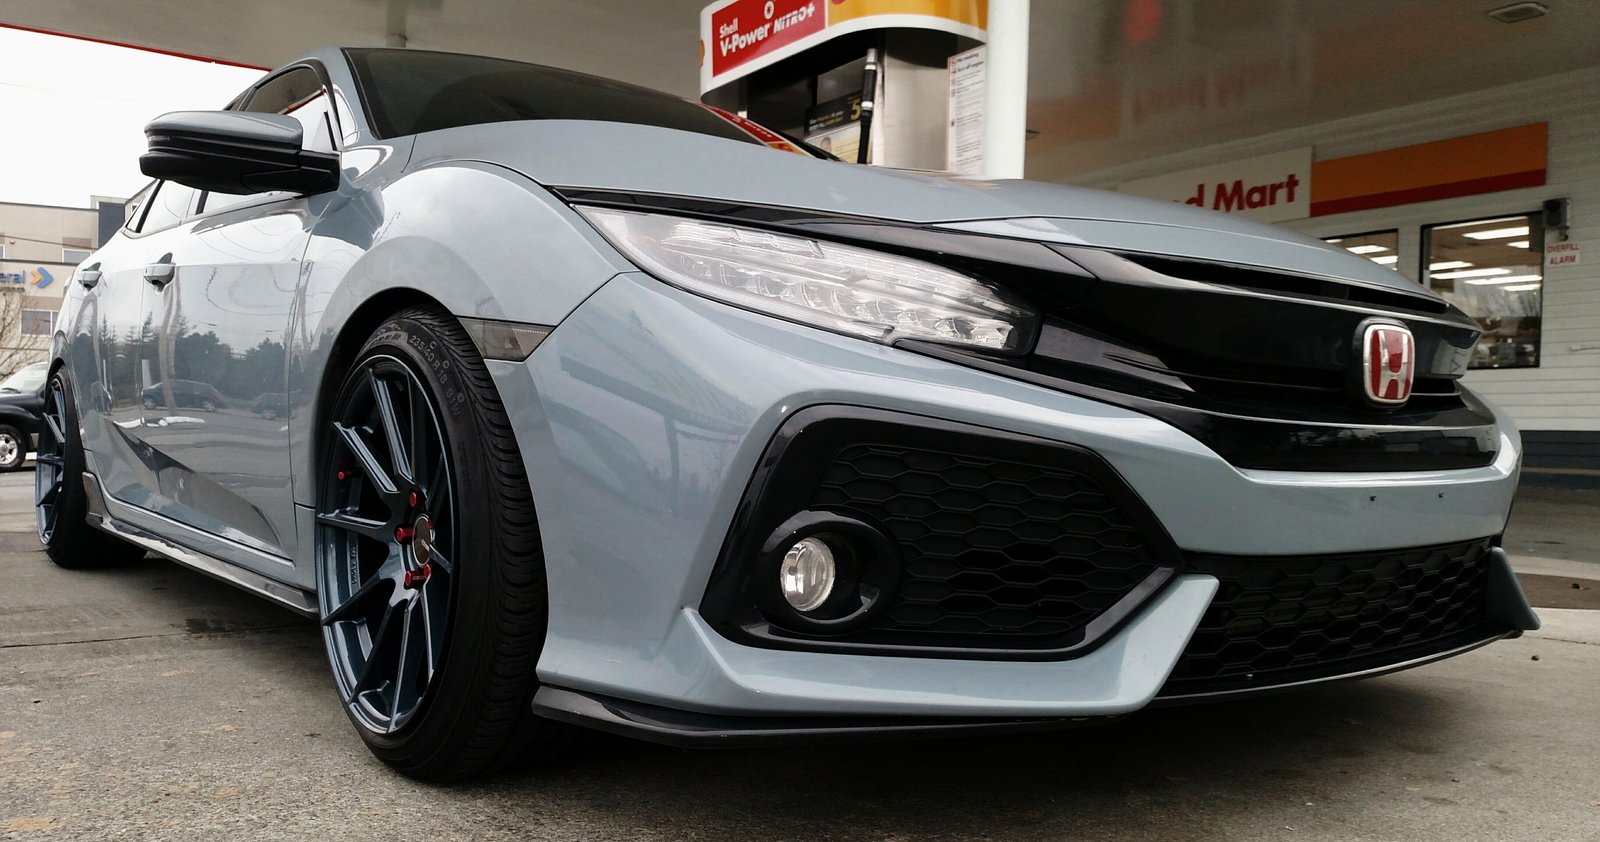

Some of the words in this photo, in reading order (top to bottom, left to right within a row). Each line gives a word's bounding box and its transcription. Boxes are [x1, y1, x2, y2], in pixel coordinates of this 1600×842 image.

[719, 17, 738, 38] Shell
[720, 24, 771, 57] V-Power
[1212, 173, 1300, 213] Mart
[1546, 242, 1580, 253] OVERFILL
[1549, 254, 1576, 265] ALARM
[409, 335, 435, 362] 235/40
[432, 359, 441, 371] R
[438, 370, 448, 384] 18
